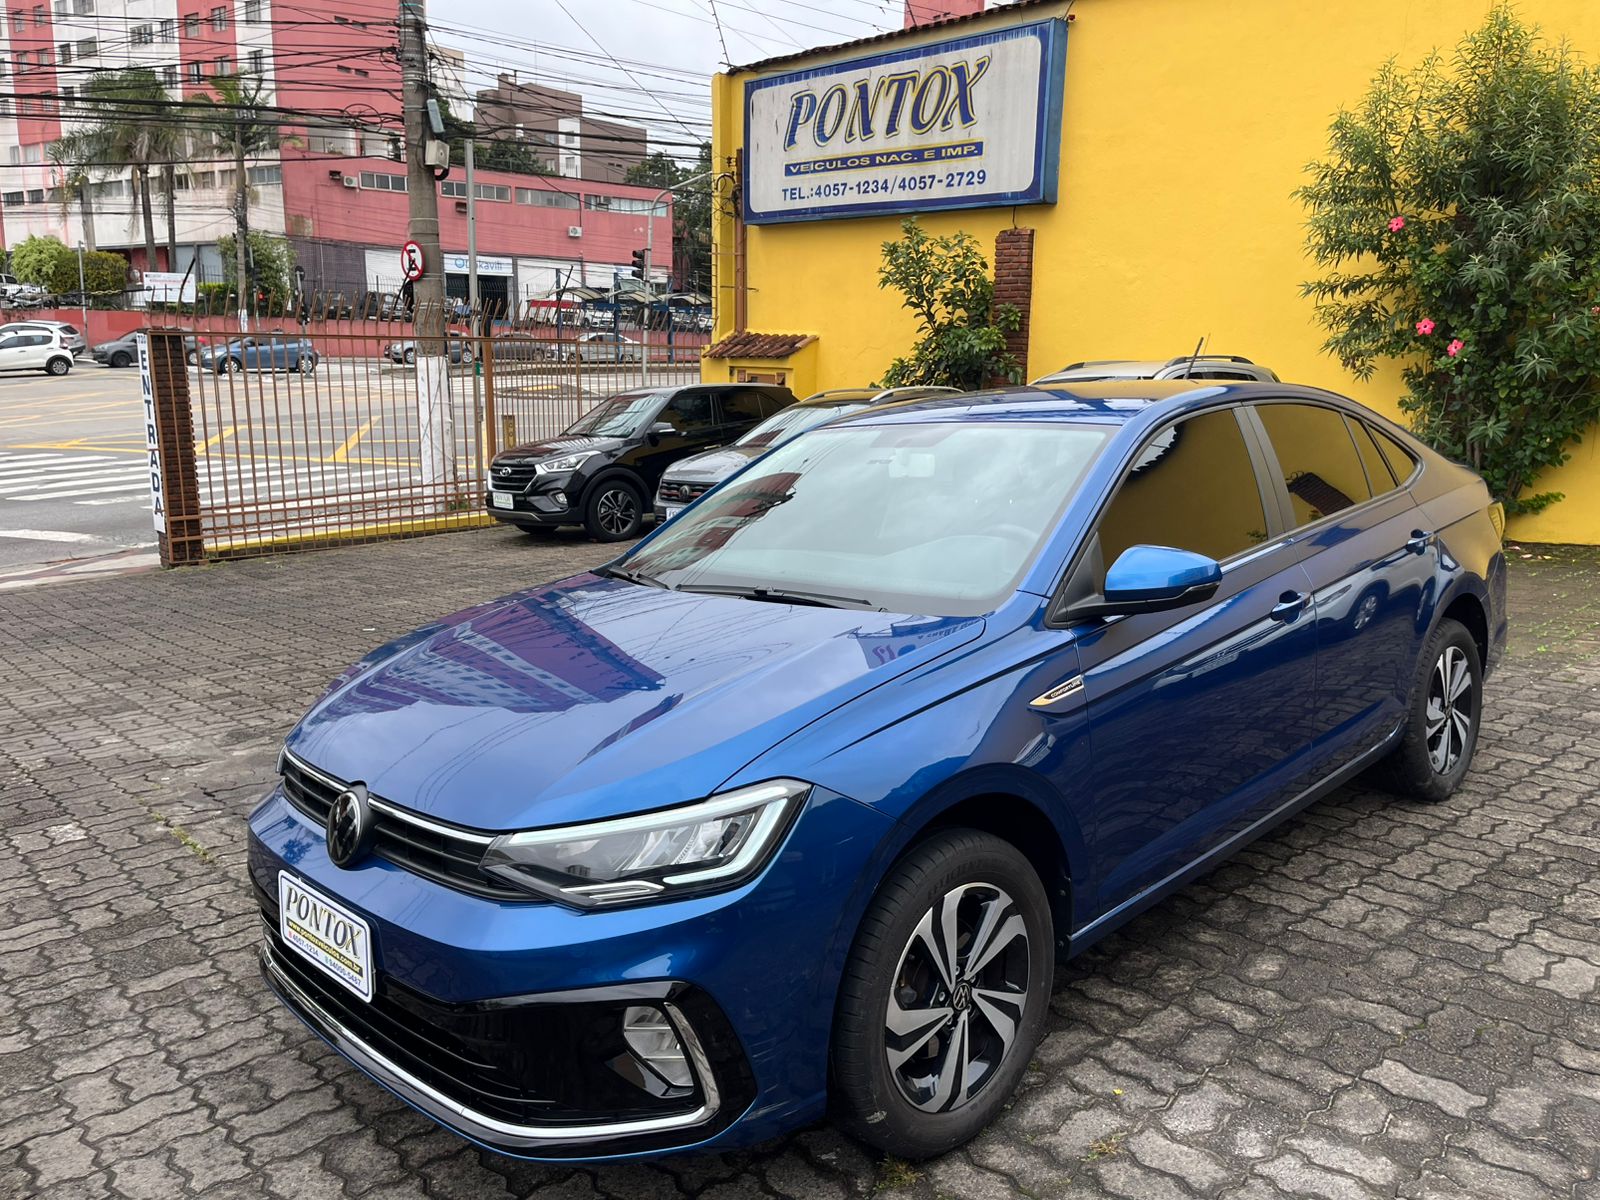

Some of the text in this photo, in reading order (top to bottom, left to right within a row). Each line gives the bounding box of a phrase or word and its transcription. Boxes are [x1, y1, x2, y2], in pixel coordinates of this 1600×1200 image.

[784, 55, 991, 152] PONTOX
[875, 152, 918, 164] NAC.
[924, 150, 935, 159] E
[941, 144, 979, 157] IMP.
[140, 350, 164, 517] ENTRADA
[286, 884, 362, 960] PONTOX
